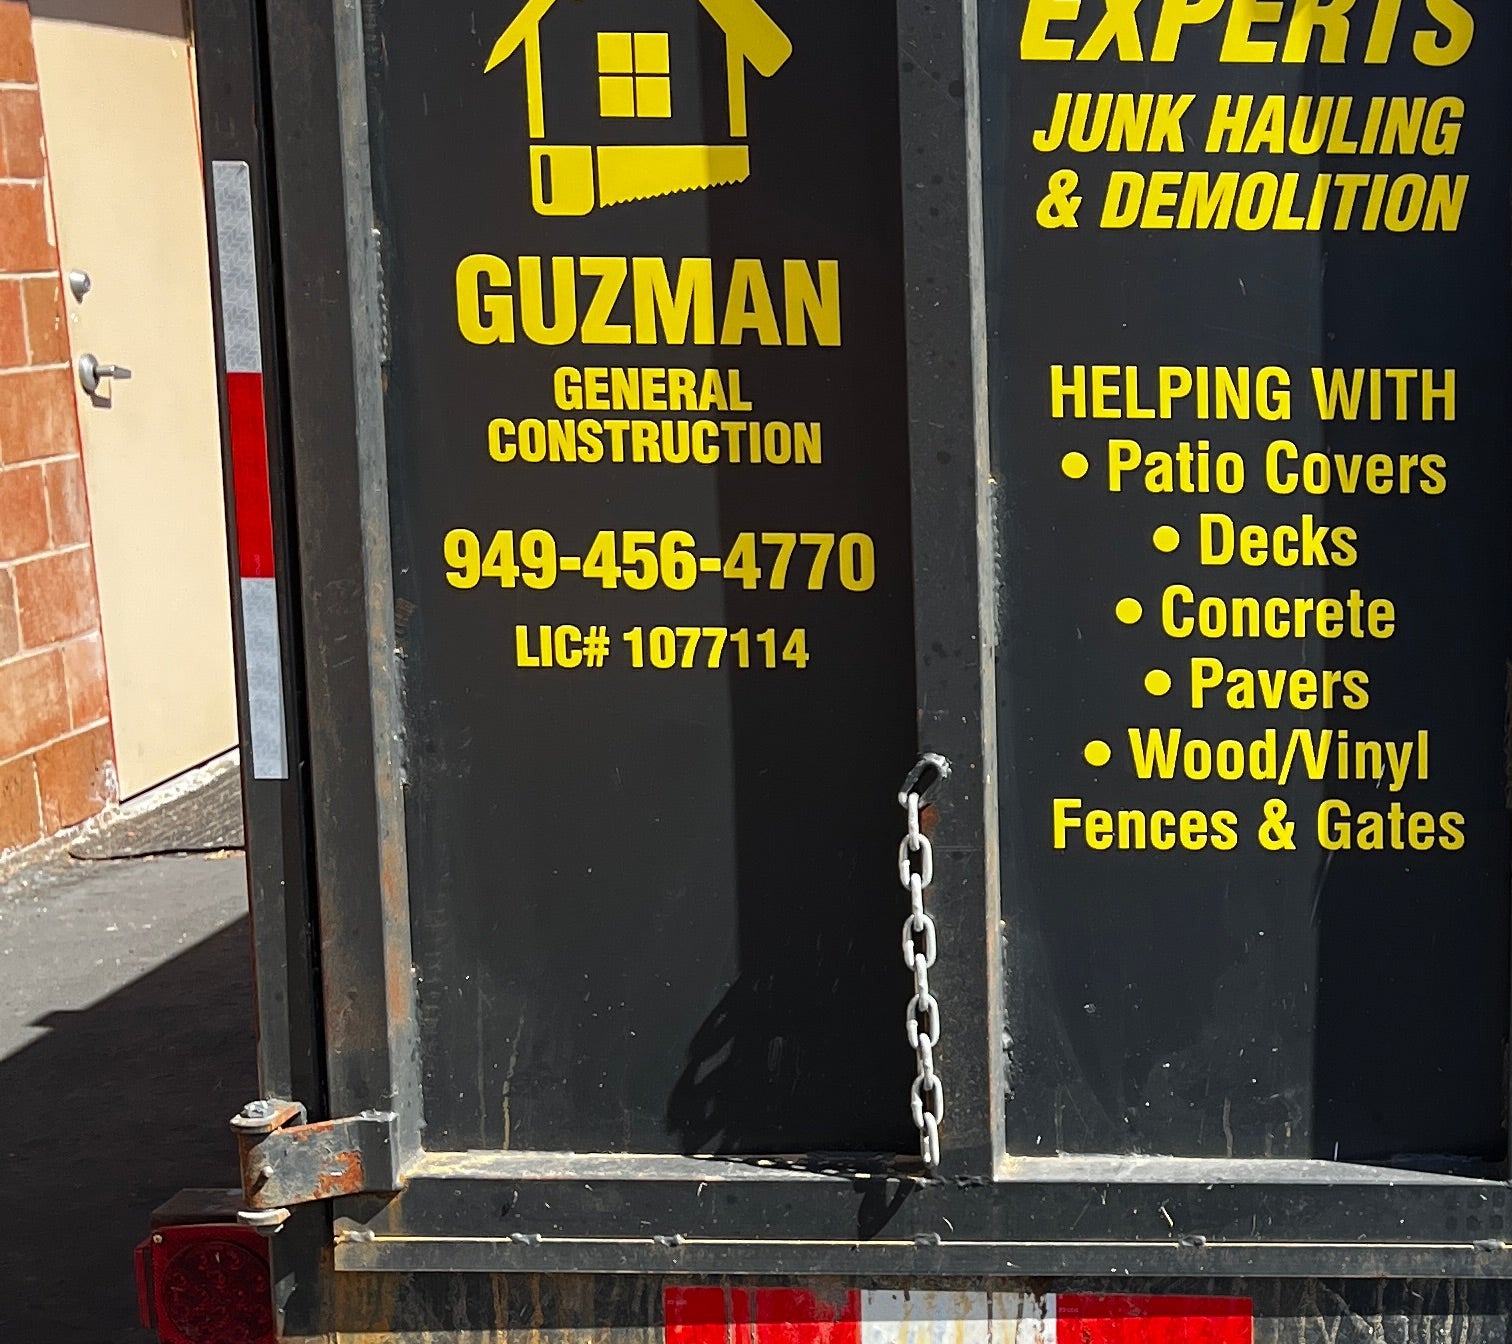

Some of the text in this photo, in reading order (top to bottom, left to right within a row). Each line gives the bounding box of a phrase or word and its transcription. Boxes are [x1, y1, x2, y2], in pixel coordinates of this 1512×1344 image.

[1032, 93, 1465, 156] JUNK HAULING
[1035, 170, 1469, 233] & DEMOLITION
[455, 254, 842, 347] GUZMAN
[553, 366, 753, 412] GENERAL
[1049, 366, 1457, 422] HELPING WITH
[487, 418, 822, 465] CONSTRUCTION
[1108, 439, 1447, 496] Patio Covers
[443, 530, 876, 592] 949-456-4770
[1199, 514, 1358, 567] Decks
[1161, 585, 1396, 639] Concrete
[515, 625, 809, 670] LIC# 1077114
[1190, 657, 1370, 711] Pavers
[1127, 728, 1430, 792] Wood/Vinyl
[1052, 798, 1466, 852] Fences & Gates
